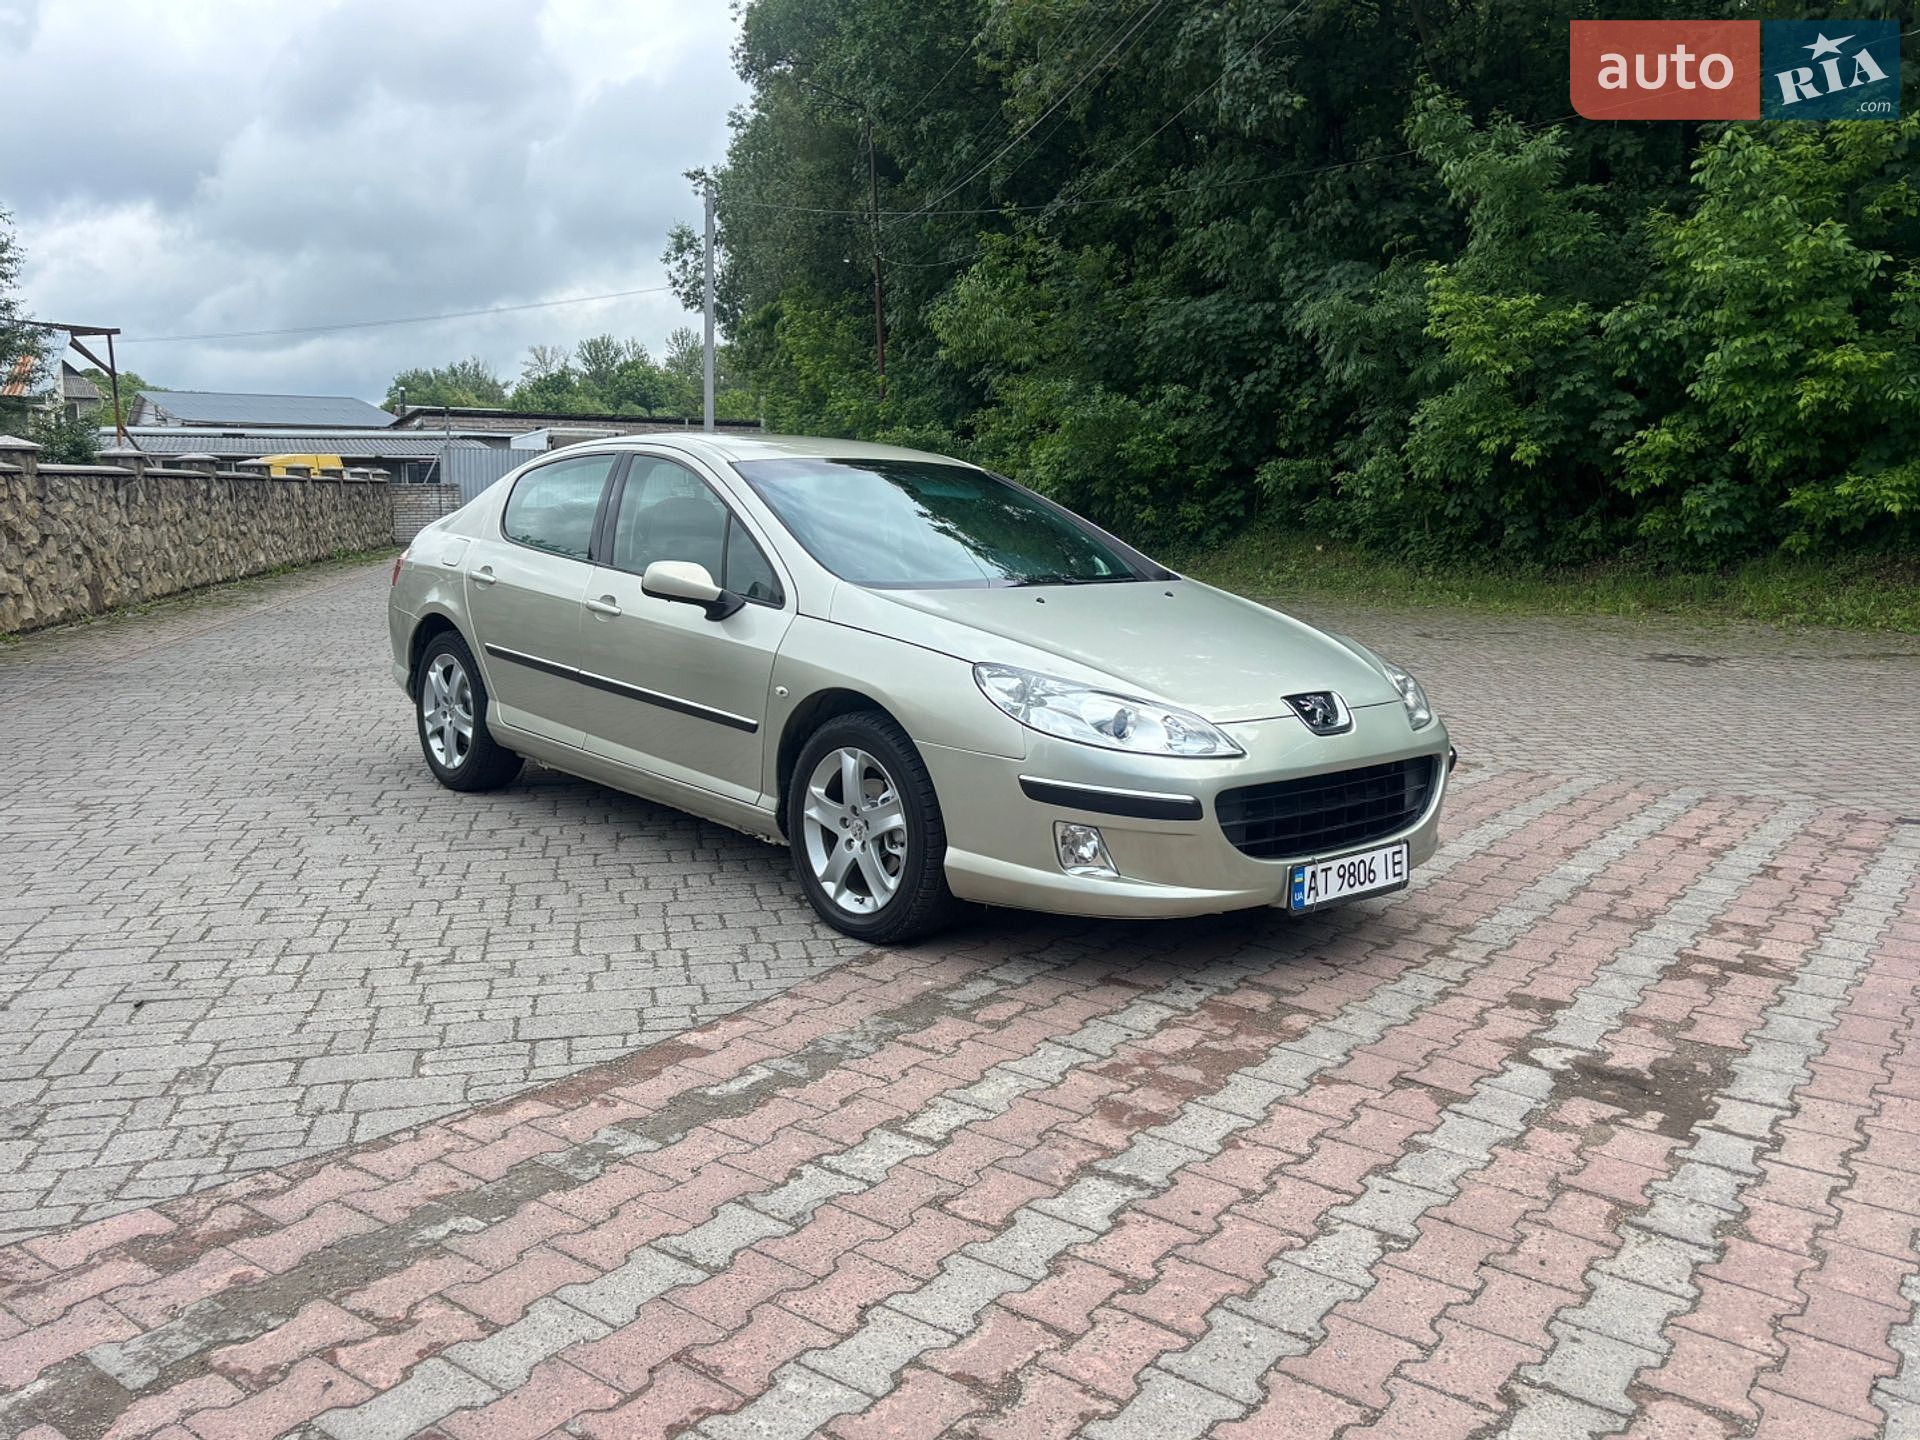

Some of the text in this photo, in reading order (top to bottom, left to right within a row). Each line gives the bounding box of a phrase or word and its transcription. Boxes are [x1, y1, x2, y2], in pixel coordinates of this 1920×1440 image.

[1306, 849, 1403, 900] AT 9806 IE
[1294, 891, 1304, 902] UA
